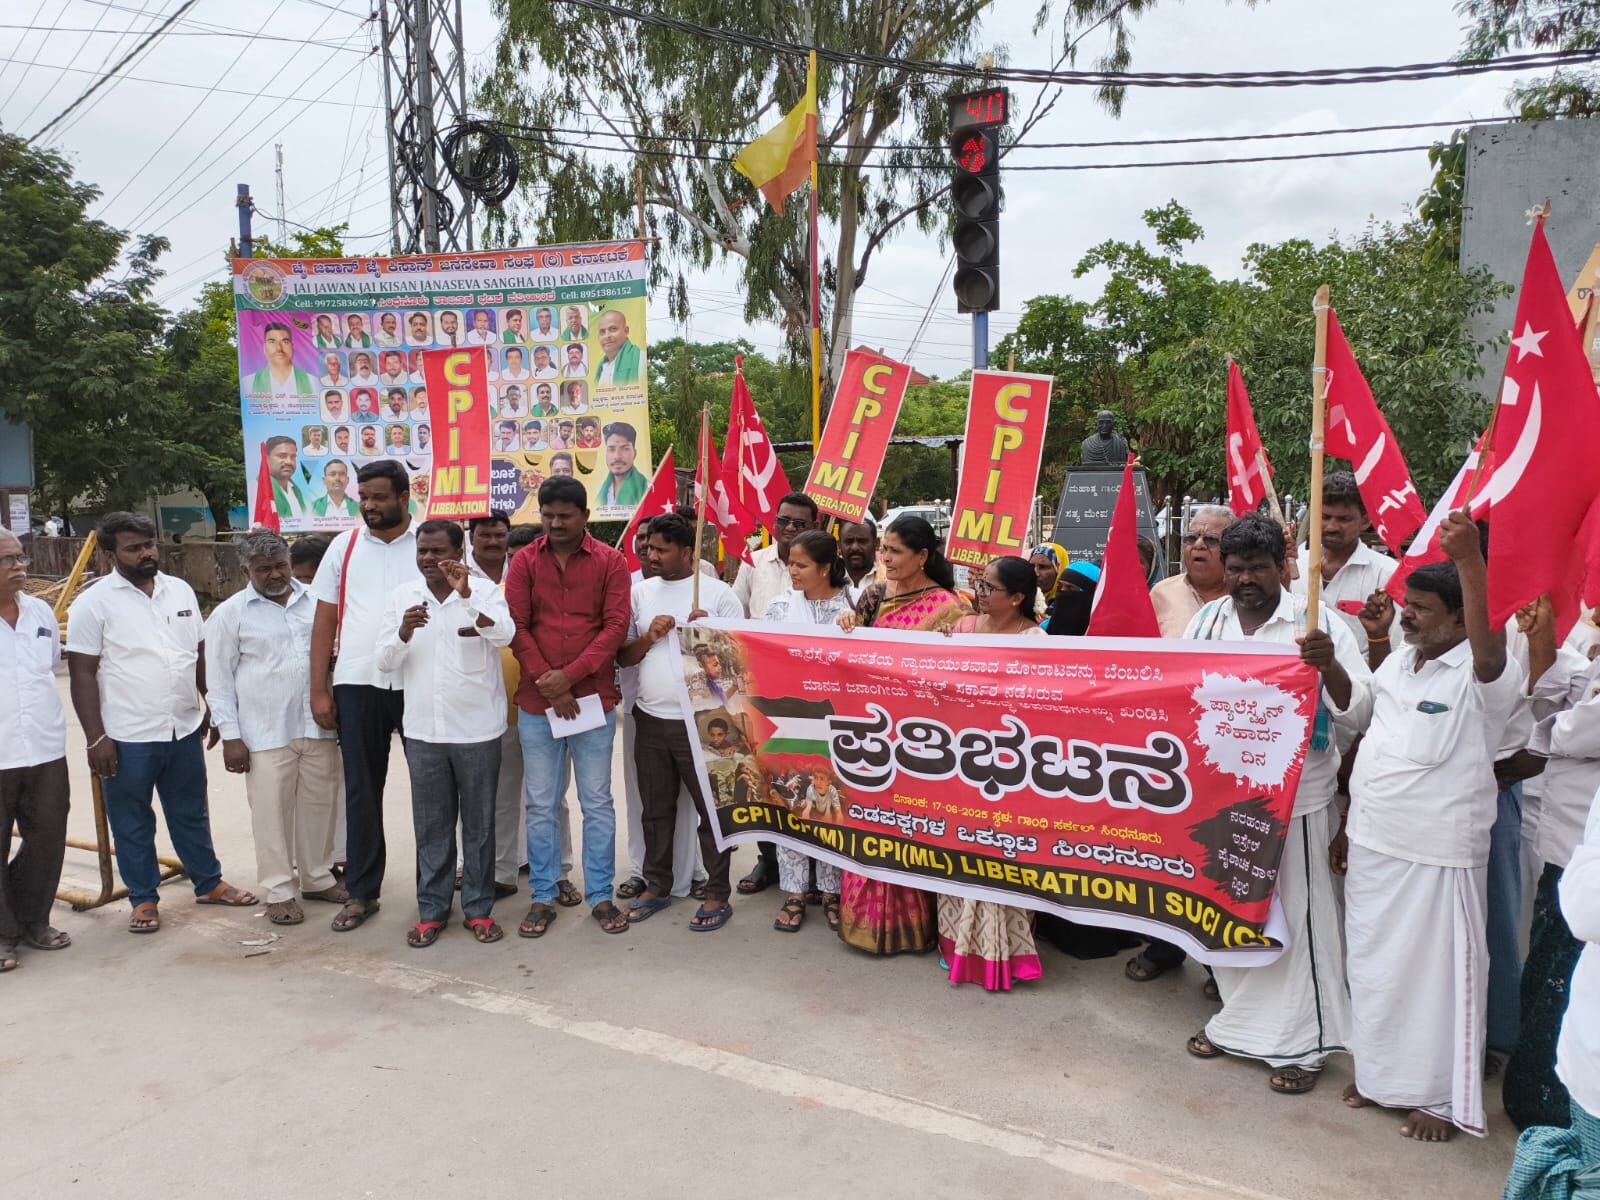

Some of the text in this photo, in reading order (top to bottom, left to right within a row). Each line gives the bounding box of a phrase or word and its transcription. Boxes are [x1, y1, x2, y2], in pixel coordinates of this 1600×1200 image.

[966, 92, 1004, 123] 40
[293, 269, 633, 296] JAI JAWAN JAI KISAN JANASEVA SANGHA (R) KARNATAKA
[434, 466, 488, 496] ML
[813, 461, 868, 498] ML
[430, 500, 487, 515] LIBERATION
[956, 509, 1021, 547] ML
[848, 652, 894, 666] ಜನತೆಯ
[1104, 663, 1164, 682] ಬೆಂಬಲಿಸಿ
[802, 680, 841, 693] ಮಾನವ
[1215, 722, 1282, 742] ಸೌಹಾರ್ದ
[825, 701, 1192, 814] ಪ್ರತಿಭಟನೆ
[1241, 750, 1266, 766] ದಿನ
[932, 801, 989, 819] 17-06-2025
[1017, 814, 1048, 829] ಗಾಂಧಿ
[1230, 811, 1271, 834] ನರಹಂತಕ
[848, 803, 1196, 880] ಎಡಪಕ್ಷಗಳ ಒಕ್ಕೂಟ ಸಿಂಧನೂರು
[731, 806, 771, 825] CPI
[862, 836, 953, 875] CPI(ML)
[960, 855, 1137, 905] LIBERATION
[1165, 891, 1221, 936] SUCI
